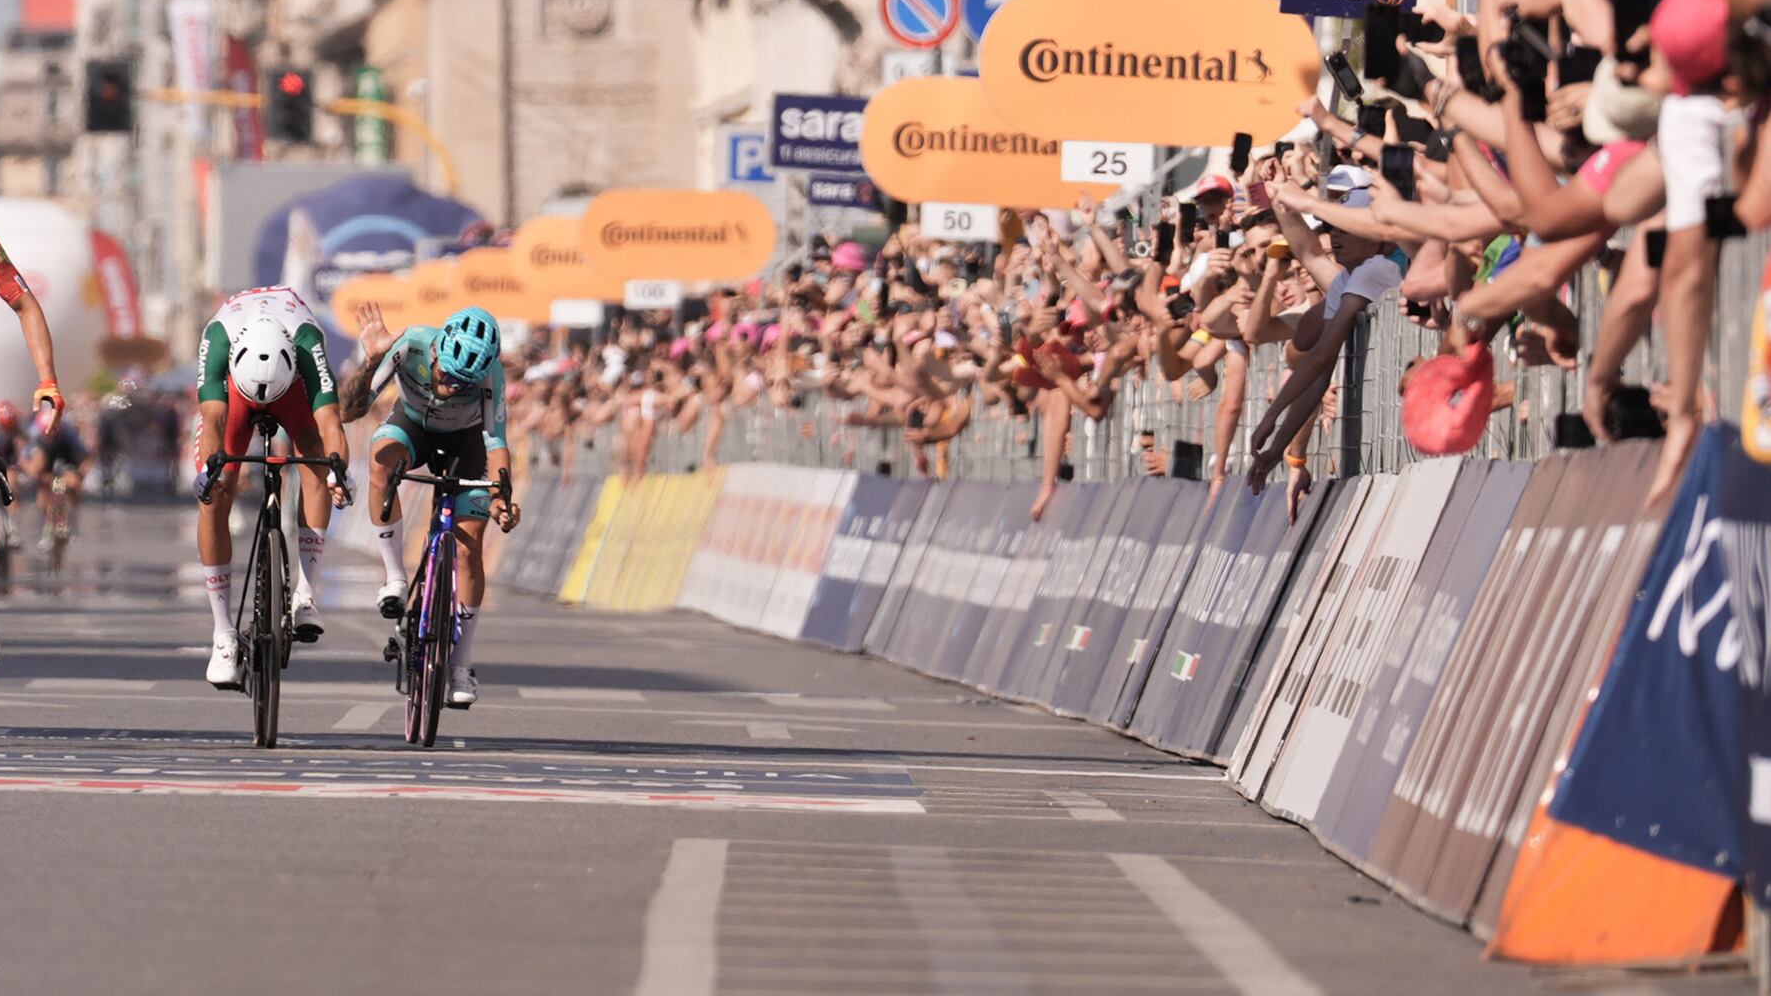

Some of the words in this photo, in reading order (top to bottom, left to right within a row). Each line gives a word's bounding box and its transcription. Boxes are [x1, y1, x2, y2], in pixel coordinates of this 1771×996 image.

[1018, 38, 1238, 83] Continental
[780, 107, 863, 142] sara
[893, 121, 1059, 158] Continenta
[1090, 152, 1129, 176] 25
[811, 181, 855, 202] sara
[942, 210, 972, 231] 50
[310, 342, 335, 394] KOMETA
